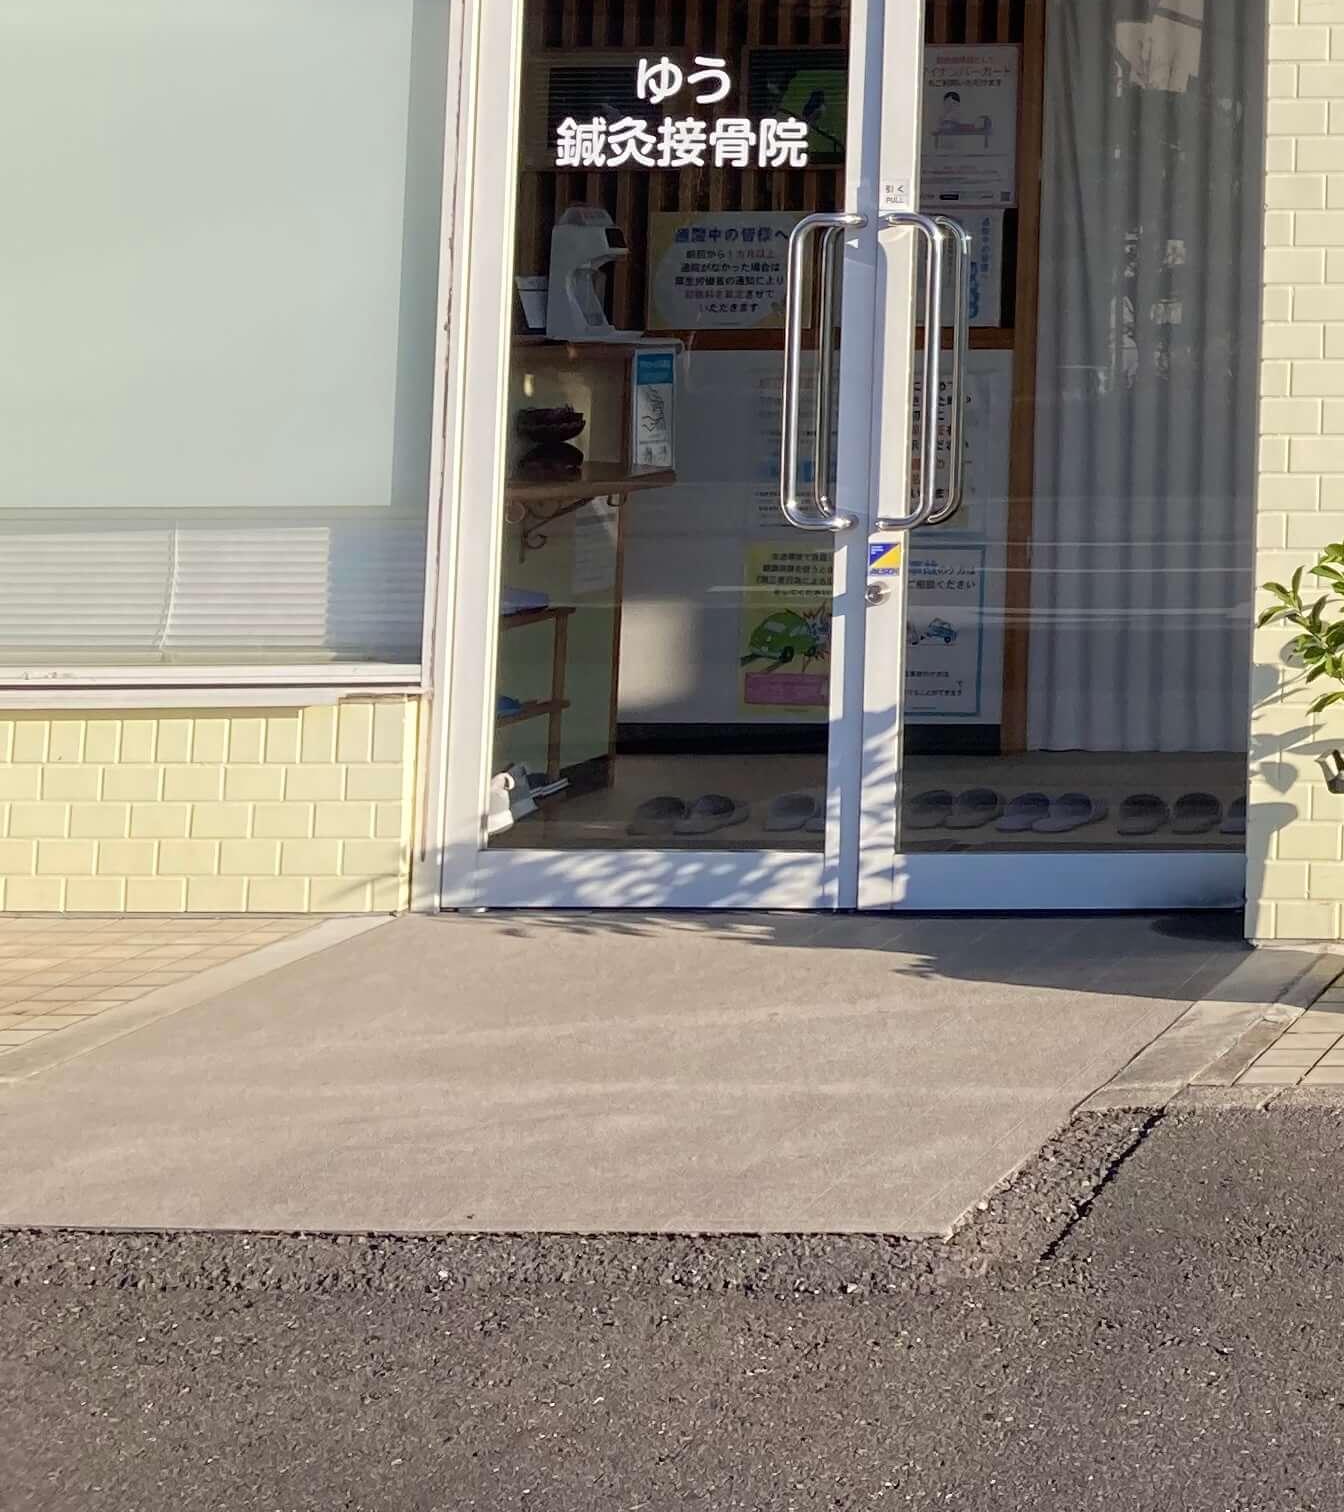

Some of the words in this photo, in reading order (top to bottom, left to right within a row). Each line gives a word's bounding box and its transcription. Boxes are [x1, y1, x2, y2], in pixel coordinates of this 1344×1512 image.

[636, 55, 731, 104] ゆう
[555, 116, 809, 169] 鍼灸接骨院
